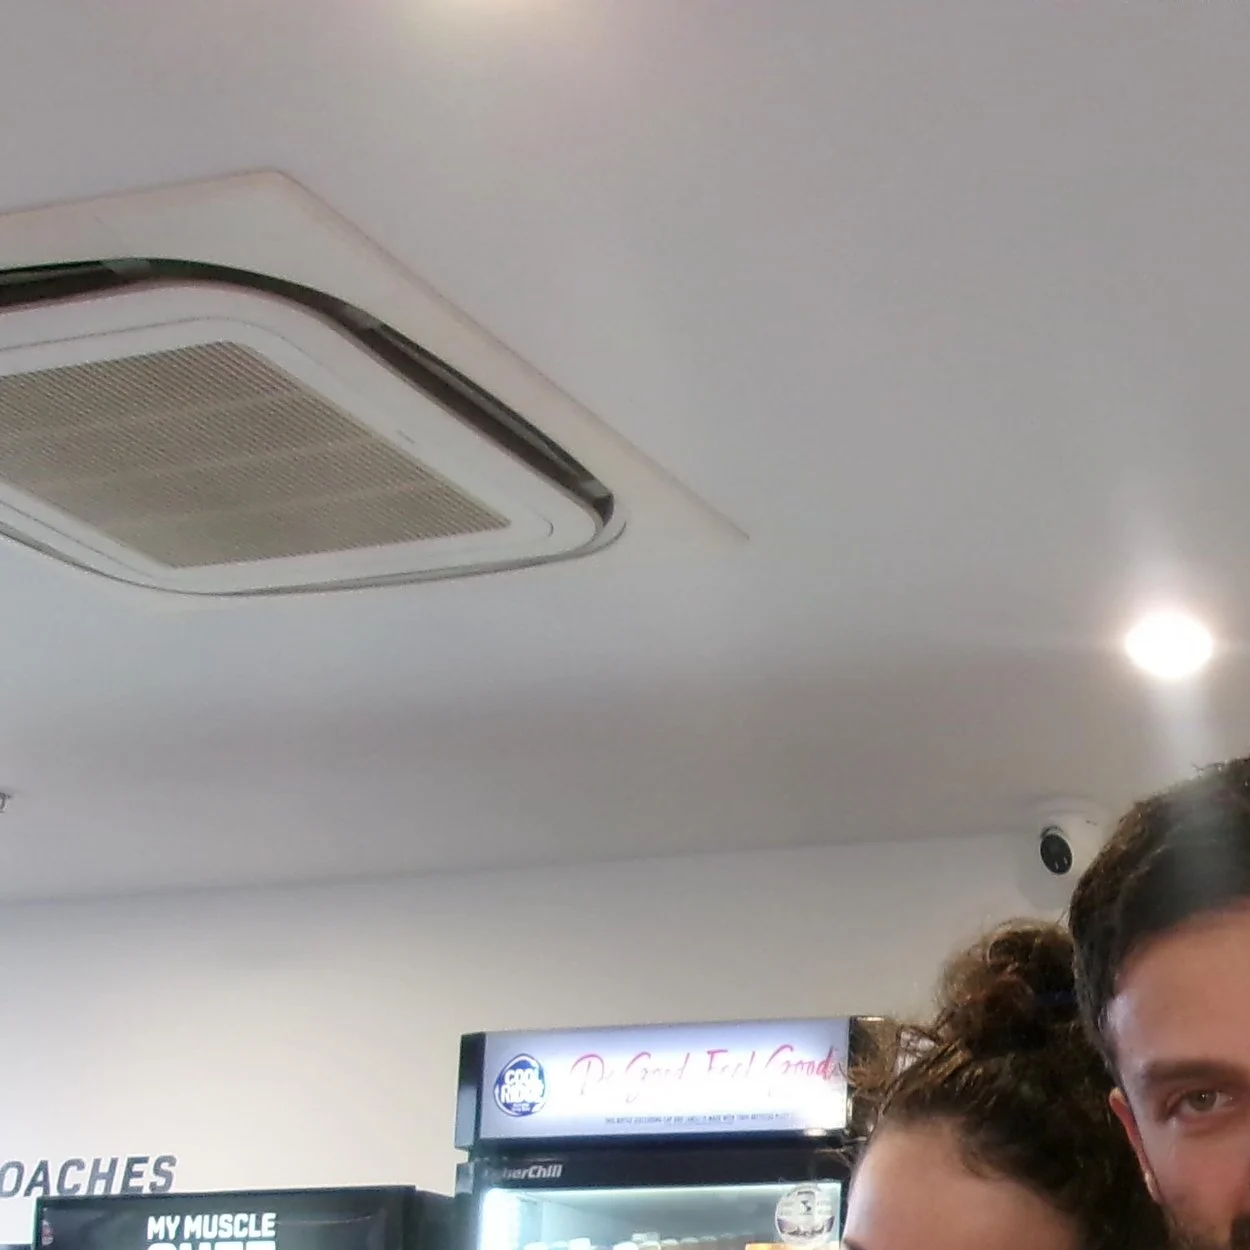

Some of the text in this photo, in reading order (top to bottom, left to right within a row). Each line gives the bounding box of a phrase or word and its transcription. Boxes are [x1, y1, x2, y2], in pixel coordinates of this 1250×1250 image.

[626, 1051, 690, 1103] Good
[147, 1212, 278, 1240] MY MUSCLE
